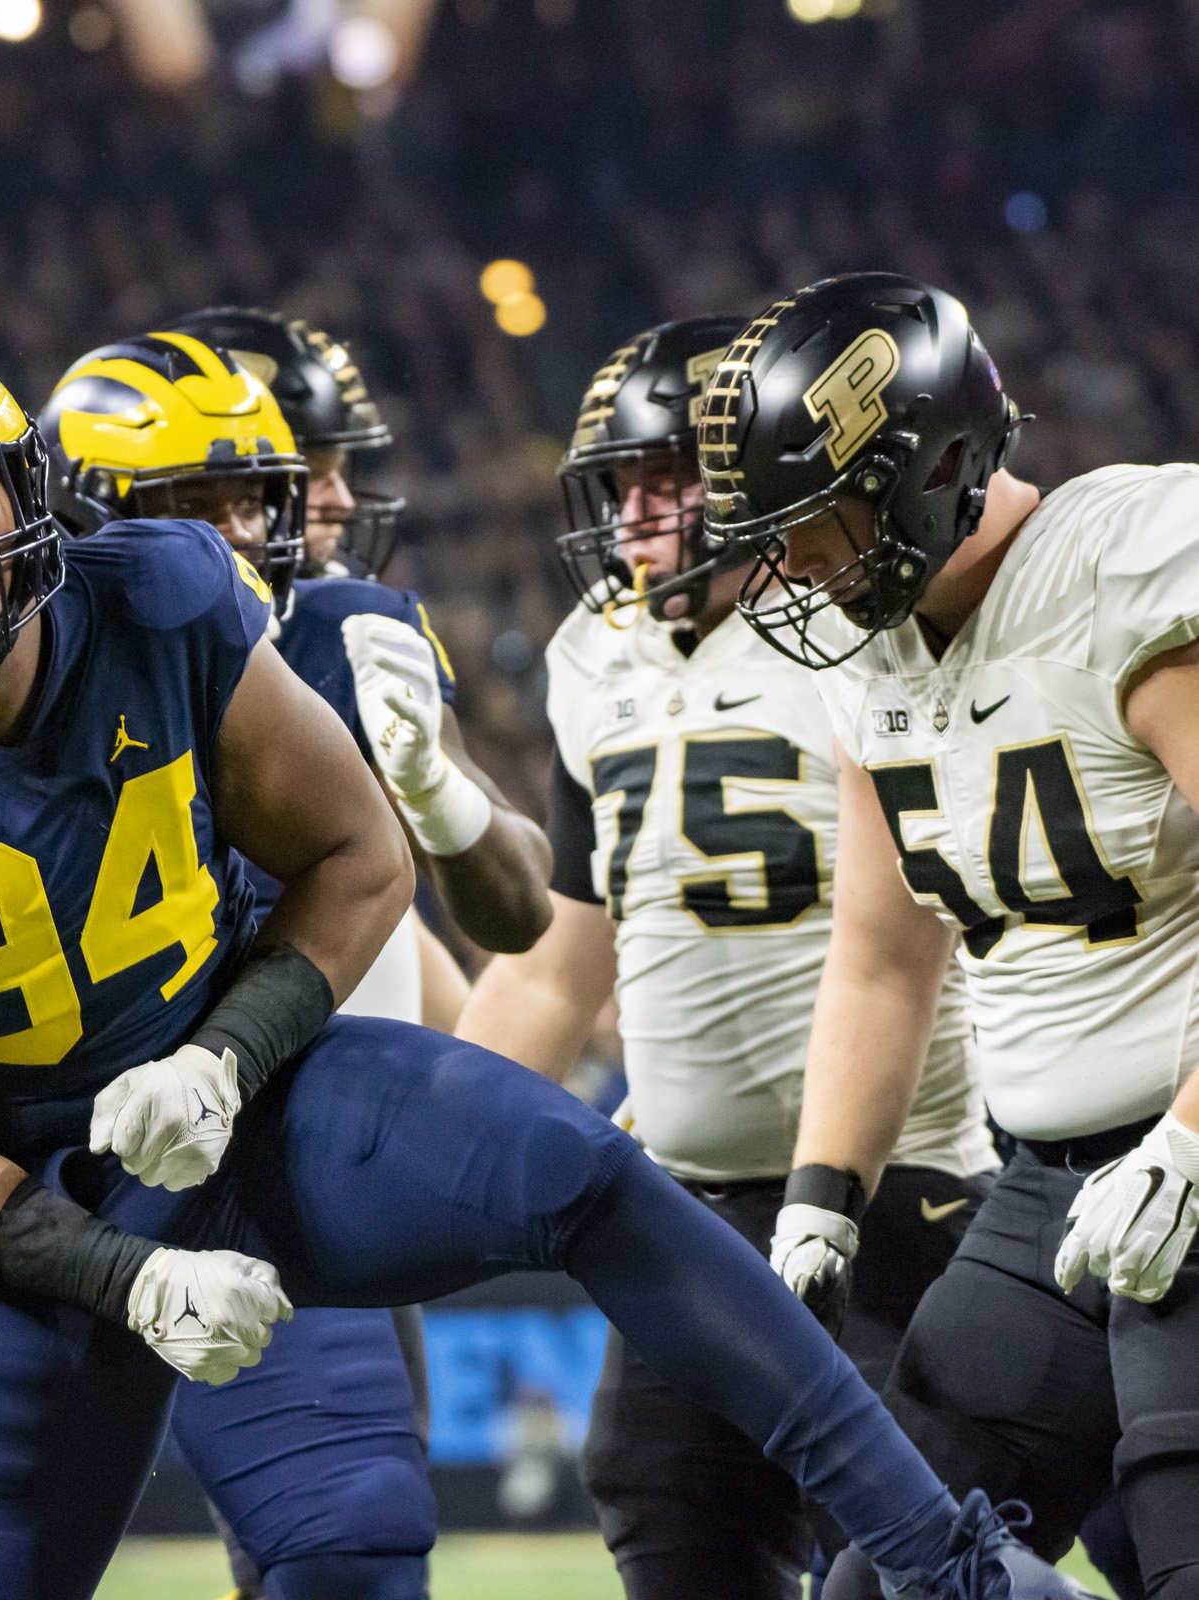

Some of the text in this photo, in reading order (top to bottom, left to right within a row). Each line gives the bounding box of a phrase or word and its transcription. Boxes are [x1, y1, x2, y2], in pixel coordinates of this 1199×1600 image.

[802, 327, 900, 472] P
[589, 727, 826, 946] 75
[862, 733, 1148, 961] 54
